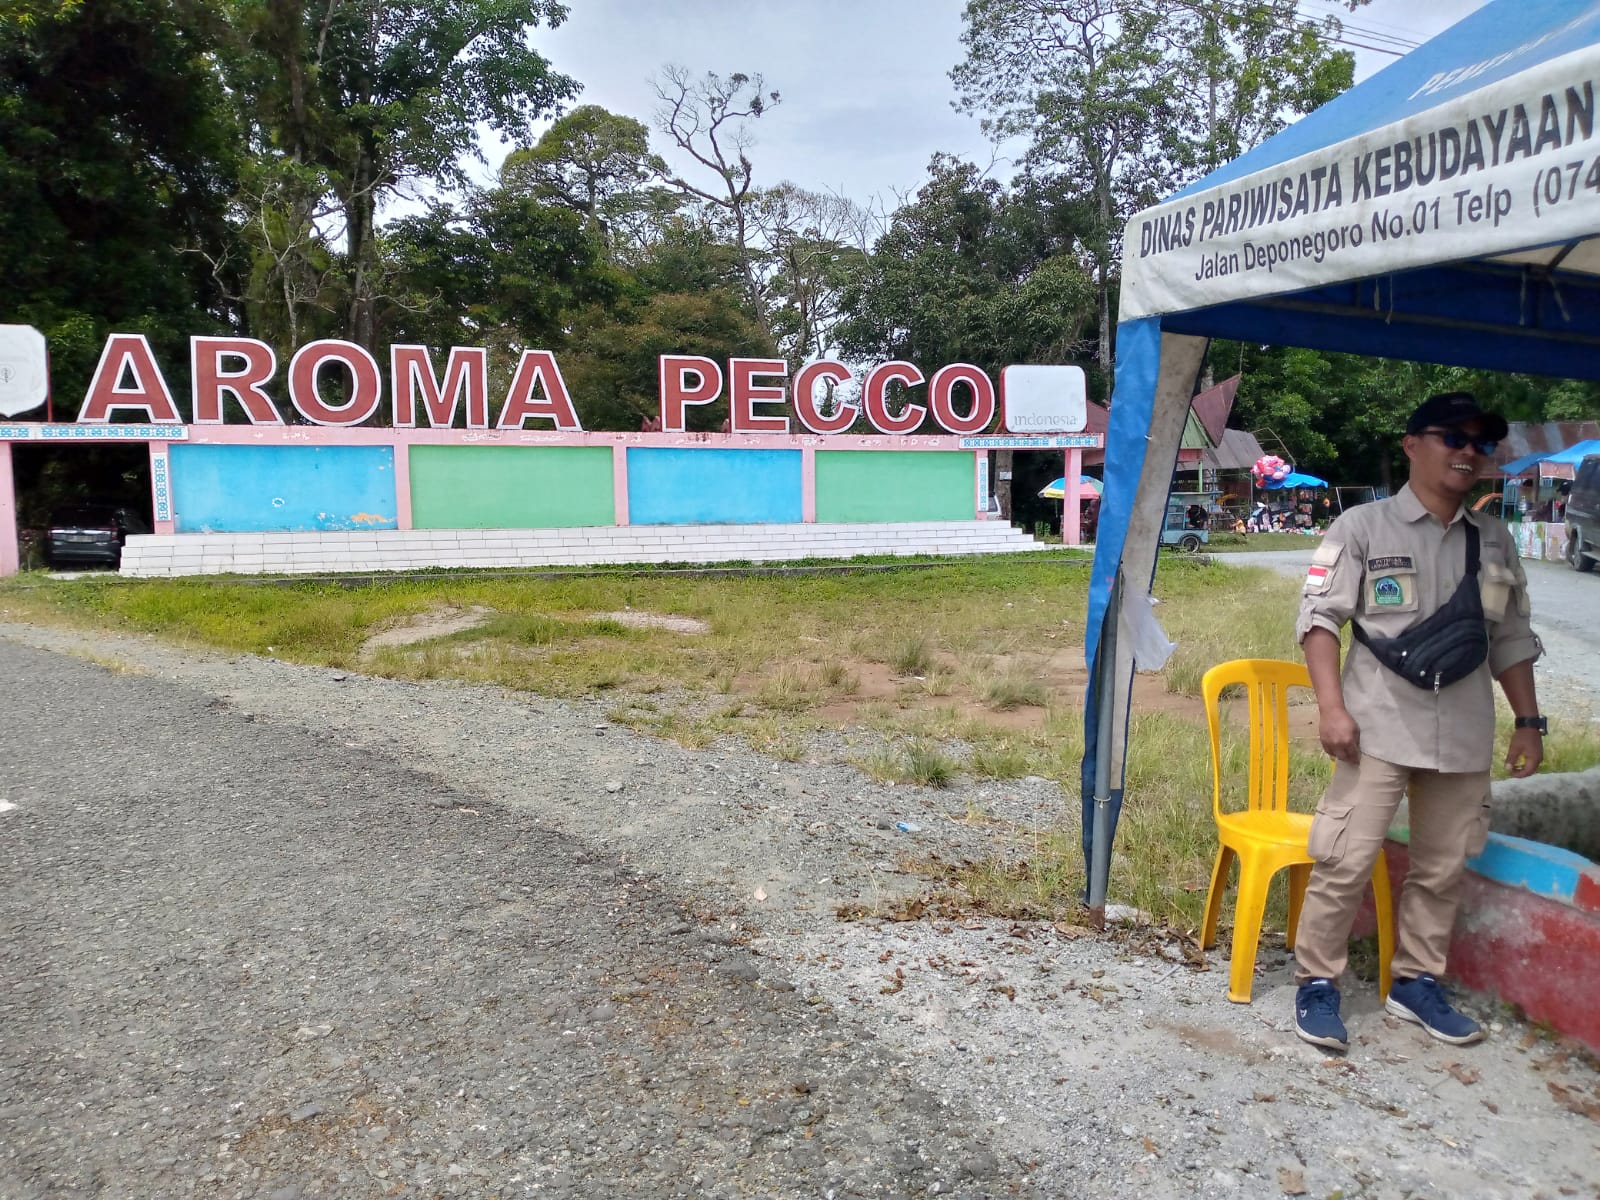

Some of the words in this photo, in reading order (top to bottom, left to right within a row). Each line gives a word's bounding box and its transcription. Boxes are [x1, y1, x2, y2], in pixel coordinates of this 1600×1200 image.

[1140, 206, 1196, 258] DINAS
[1199, 161, 1342, 242] PARIWISATA
[1352, 80, 1594, 203] KEBUDAYAAN
[1195, 252, 1239, 281] Jalan
[1243, 223, 1363, 273] Deponegoro
[1371, 196, 1440, 242] No.01
[1453, 184, 1512, 228] Telp
[76, 333, 583, 431] AROMA
[658, 355, 995, 435] PECCO
